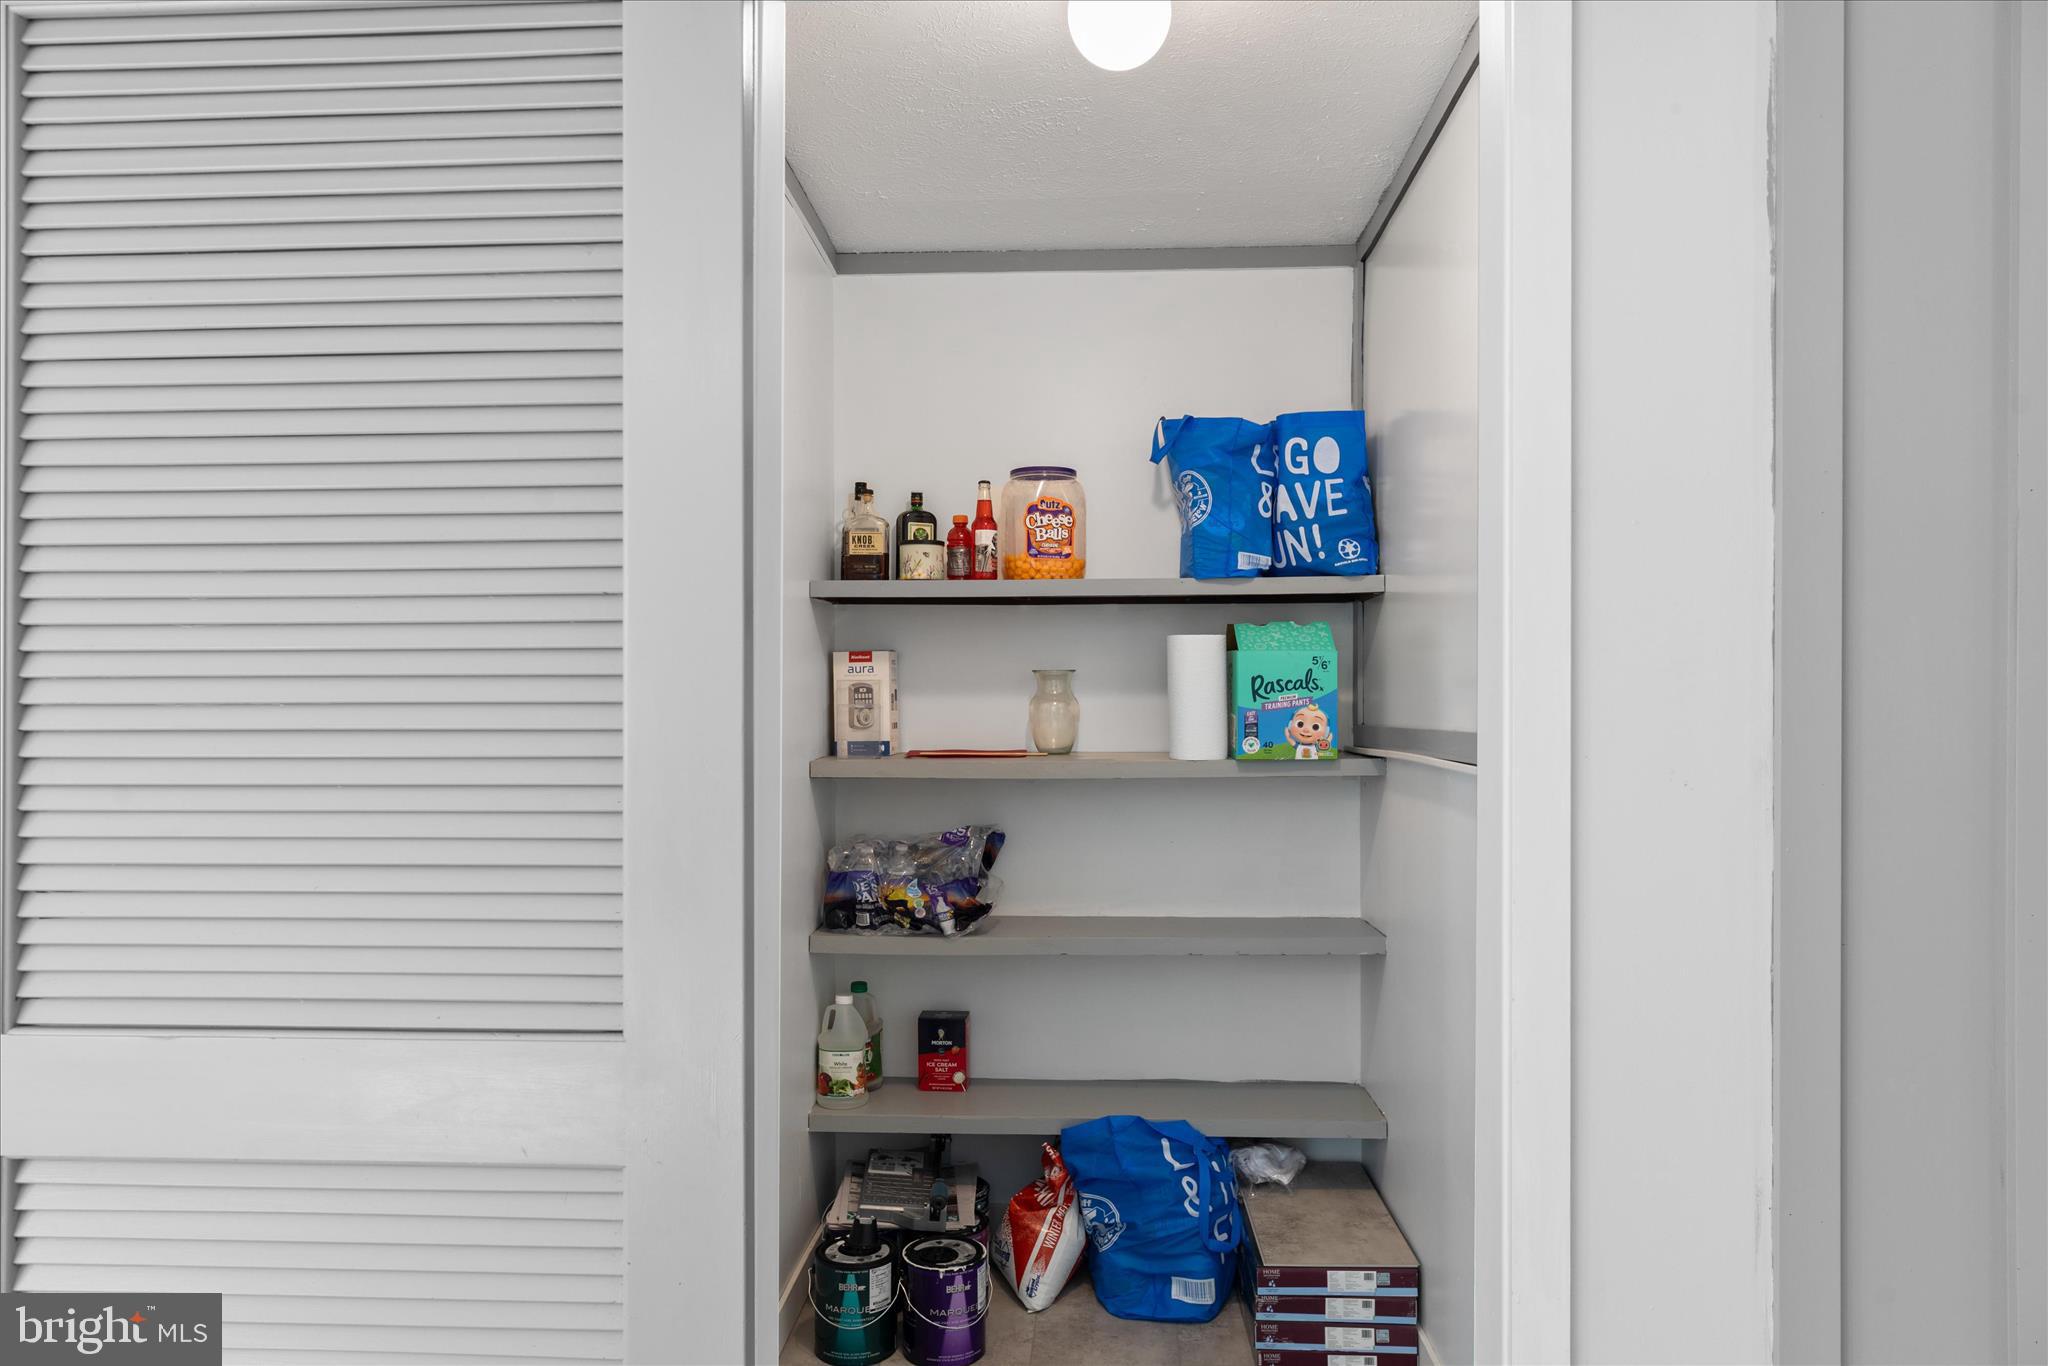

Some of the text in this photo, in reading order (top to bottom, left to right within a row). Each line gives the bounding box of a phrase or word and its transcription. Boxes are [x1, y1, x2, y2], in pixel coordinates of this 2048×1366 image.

[1284, 436, 1340, 475] GO
[1025, 512, 1073, 528] Cheese
[851, 534, 873, 545] KNOB
[1035, 527, 1069, 541] Balls
[847, 665, 875, 674] aura
[1251, 668, 1319, 702] Rascals
[1264, 698, 1311, 710] TRAINING PANTS
[1043, 1219, 1062, 1248] WINTER
[838, 1283, 858, 1291] BEHR
[946, 1284, 965, 1294] BEHR
[929, 1304, 978, 1317] MARQUE
